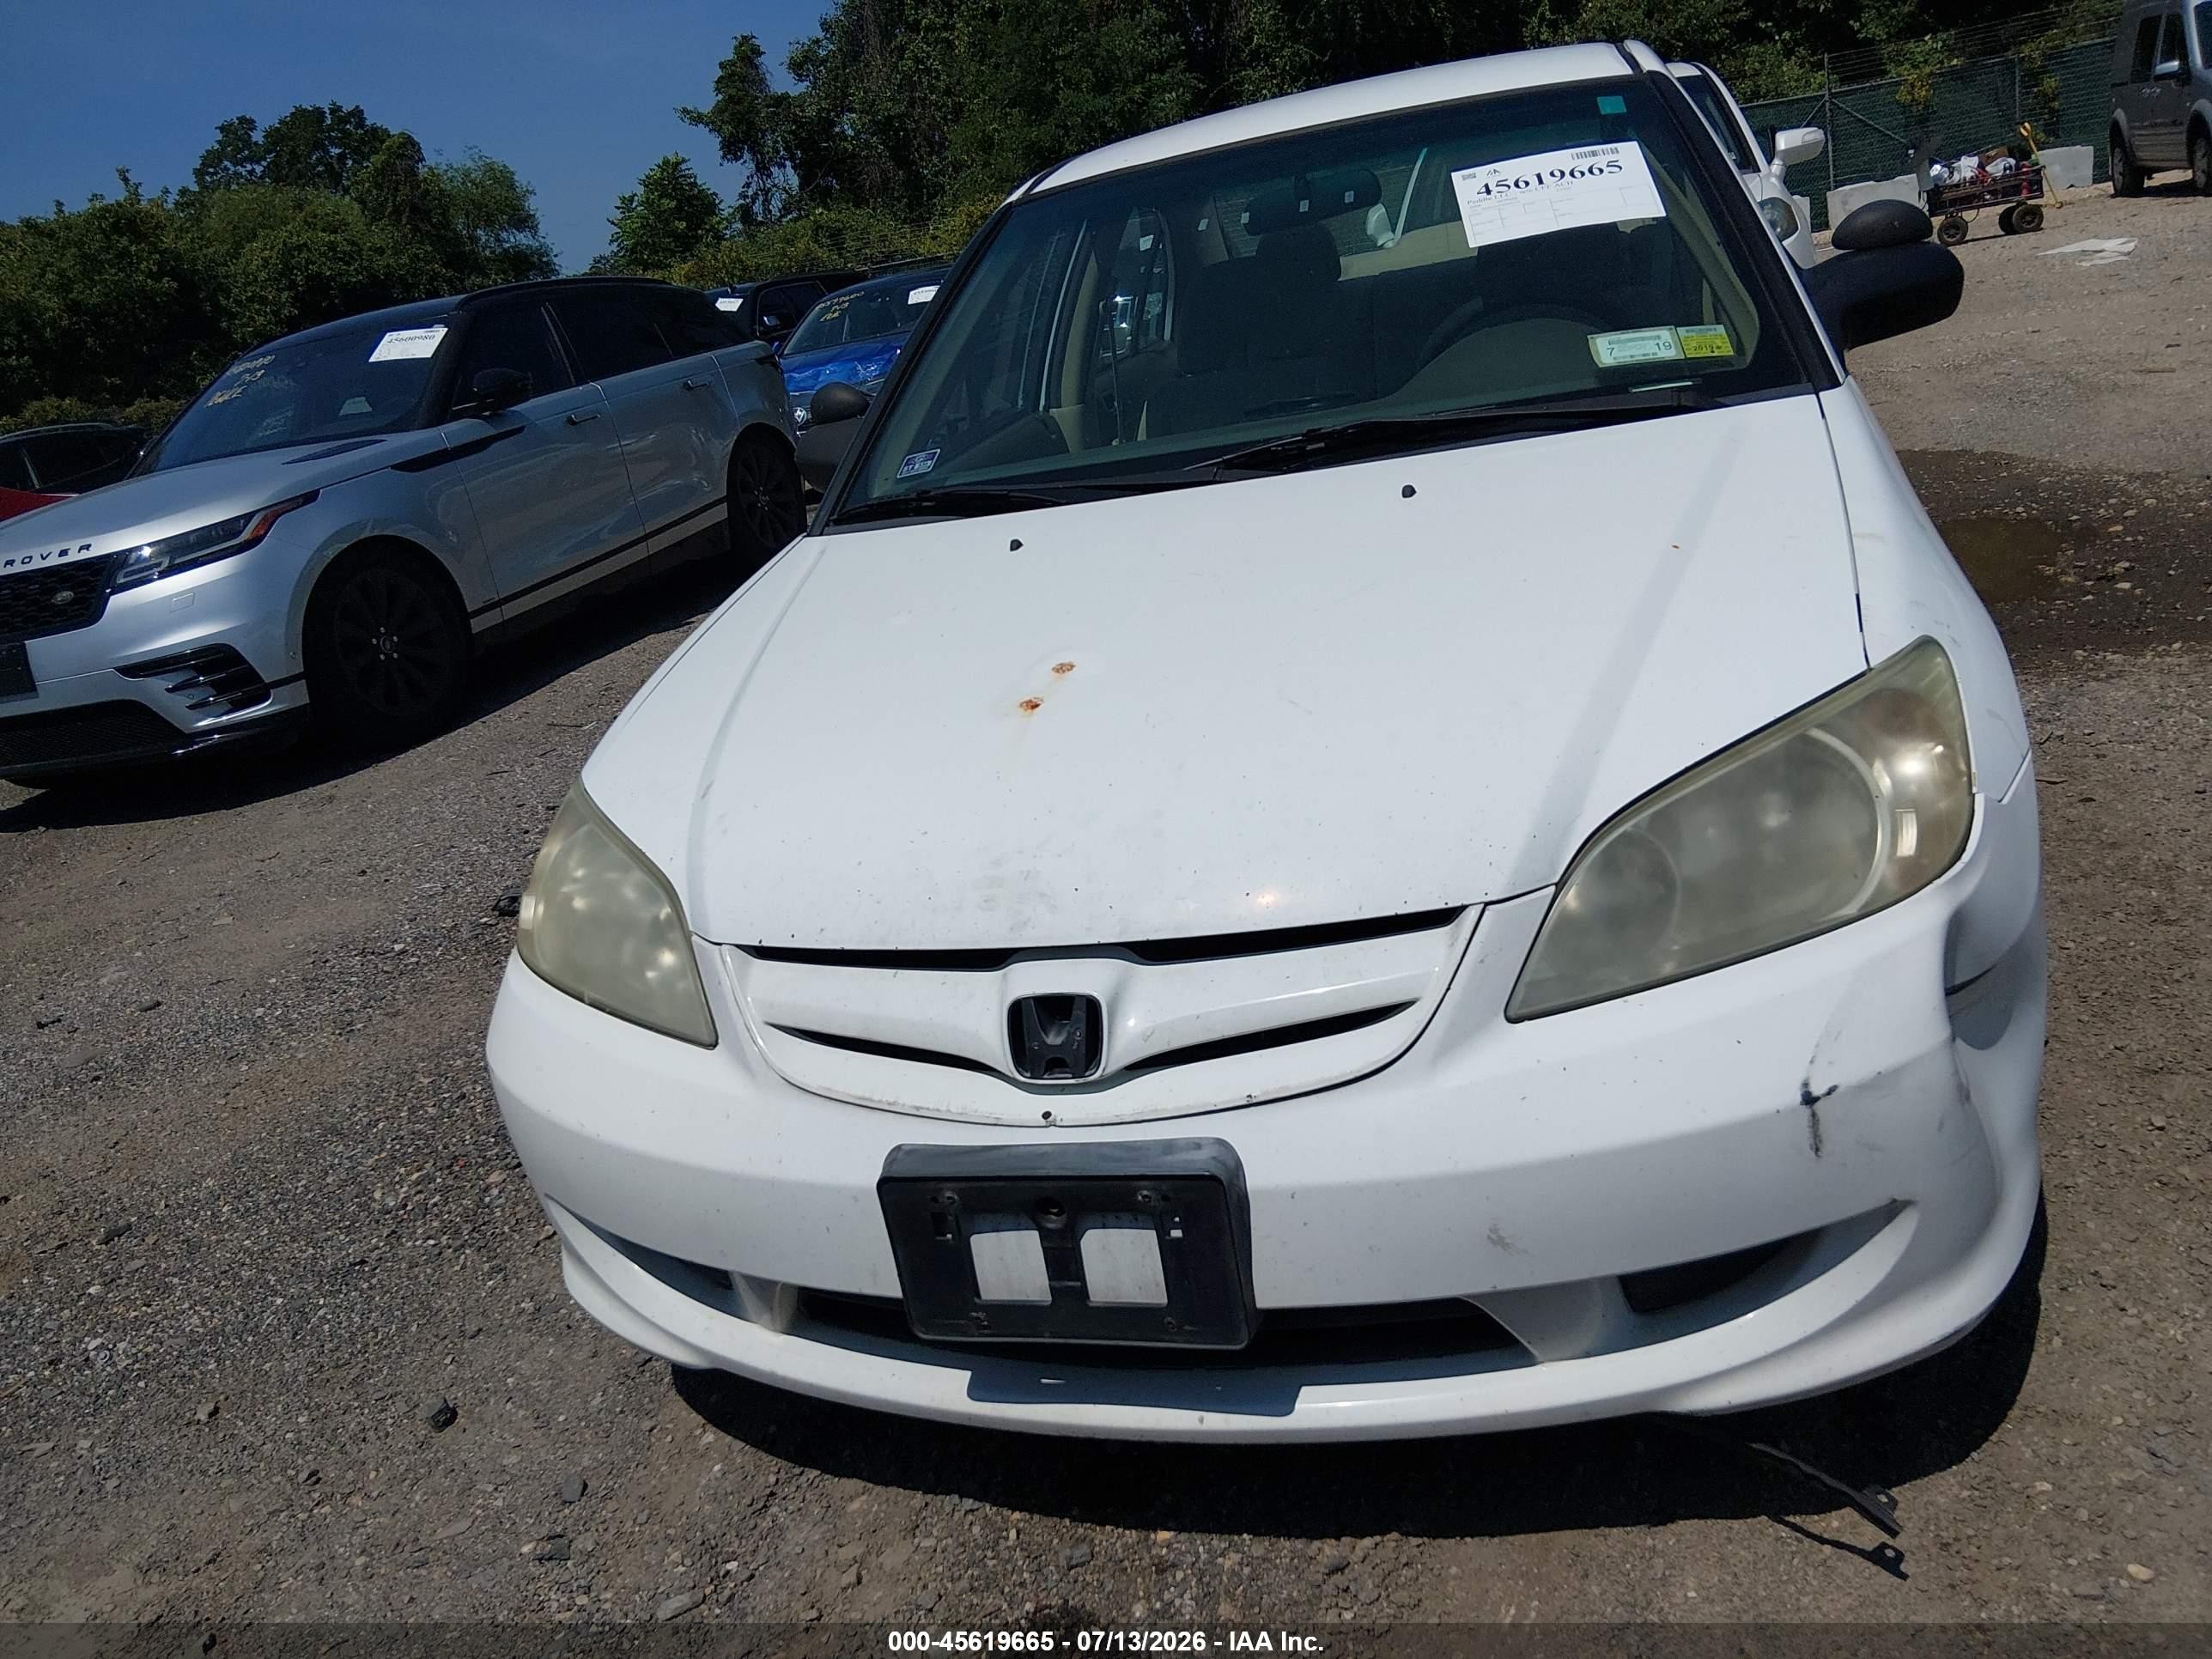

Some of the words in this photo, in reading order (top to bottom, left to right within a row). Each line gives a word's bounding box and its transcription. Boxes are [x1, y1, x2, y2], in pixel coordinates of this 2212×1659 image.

[1476, 159, 1623, 197] 45619665
[1606, 347, 1615, 357] 7
[1654, 341, 1673, 351] 19
[3, 543, 93, 568] ROVER
